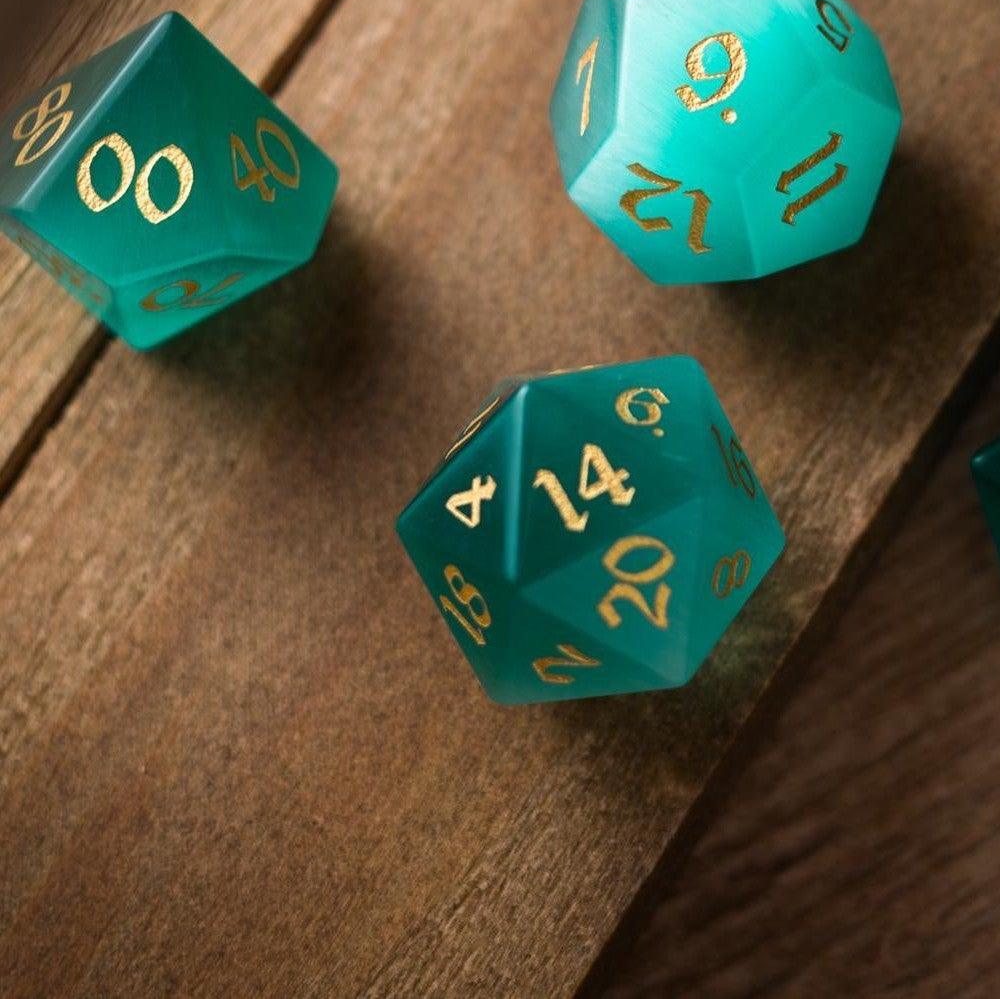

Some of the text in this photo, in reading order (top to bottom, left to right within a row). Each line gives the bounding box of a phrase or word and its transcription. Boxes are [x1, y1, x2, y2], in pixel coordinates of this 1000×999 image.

[12, 81, 75, 167] 80
[229, 116, 300, 203] 40
[76, 132, 195, 226] 00
[619, 161, 713, 255] 12
[776, 129, 849, 227] 11
[445, 474, 498, 530] 4
[532, 443, 637, 533] 14
[440, 563, 493, 647] 18
[596, 534, 677, 631] 20
[711, 549, 752, 600] 8
[532, 644, 602, 686] 2
